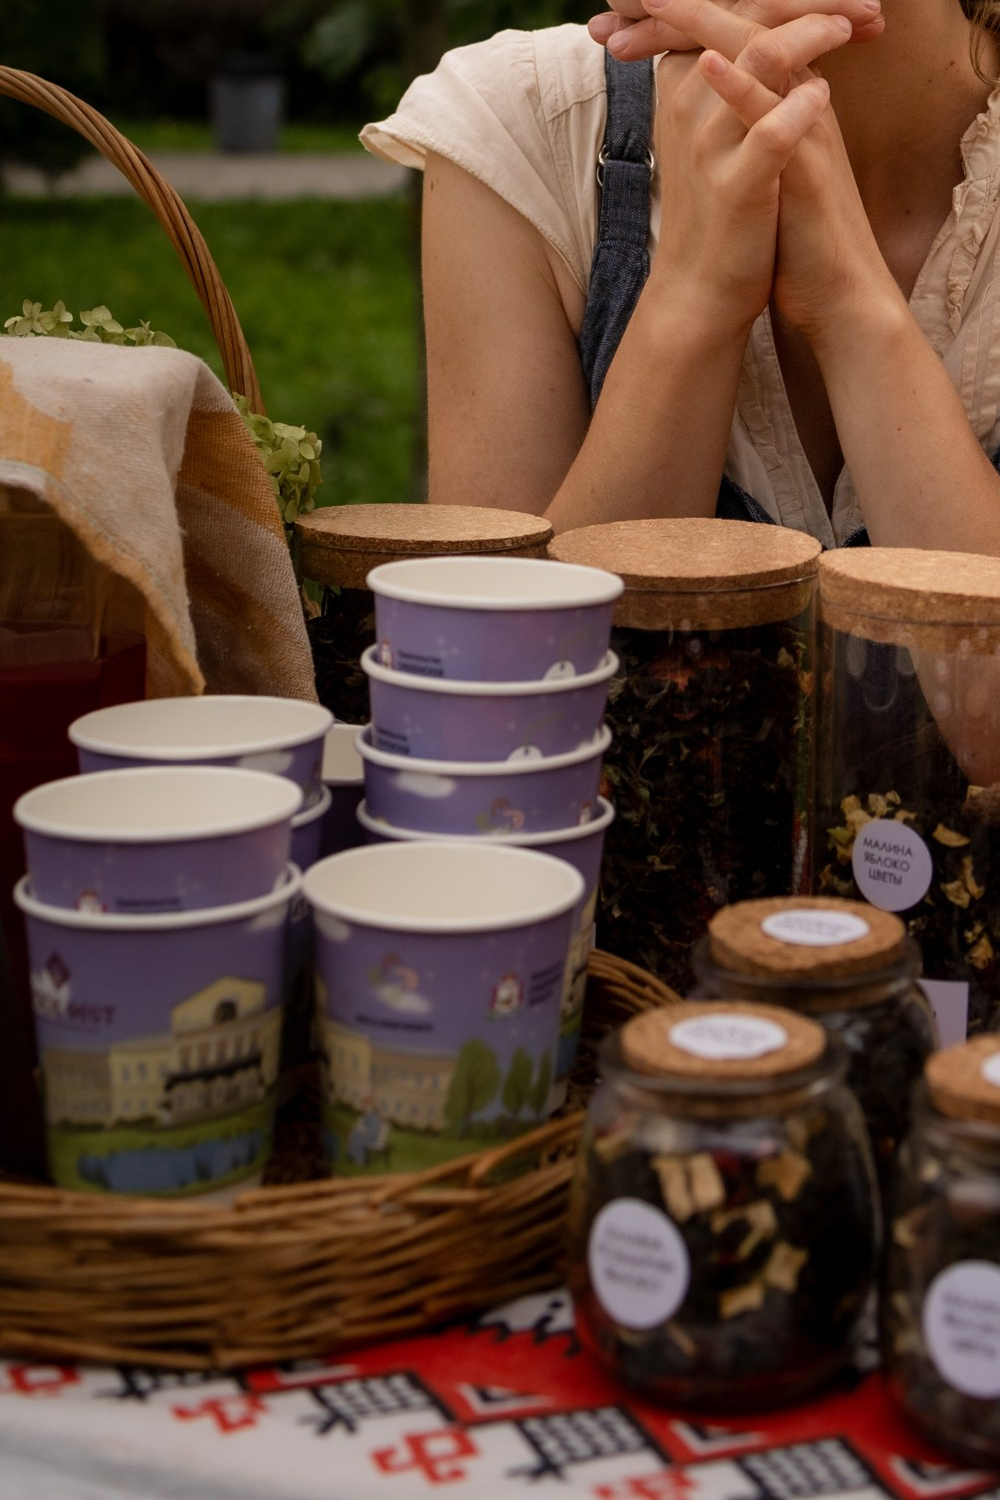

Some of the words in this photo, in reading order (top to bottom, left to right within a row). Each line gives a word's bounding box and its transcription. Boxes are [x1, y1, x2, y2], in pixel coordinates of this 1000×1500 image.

[863, 837, 913, 858] МАЛИНА
[863, 851, 911, 873] ЯБЛОКО
[868, 867, 903, 886] ЦВЕТЫ
